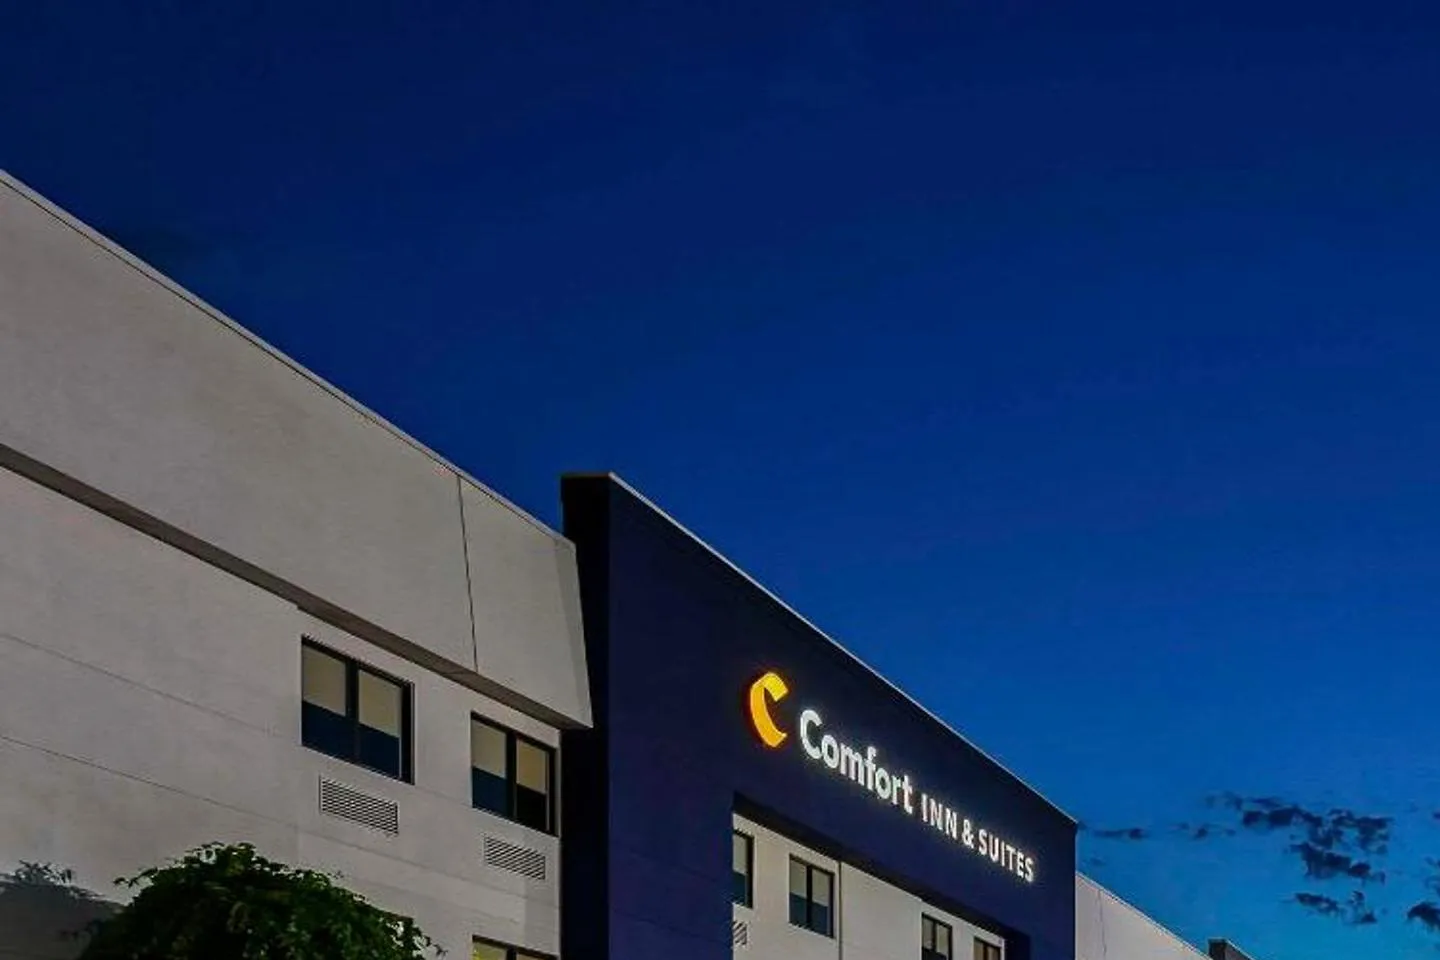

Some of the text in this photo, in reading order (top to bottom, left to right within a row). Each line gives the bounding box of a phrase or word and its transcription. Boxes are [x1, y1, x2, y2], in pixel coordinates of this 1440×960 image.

[800, 709, 1035, 883] Comfort INN & SUITES
